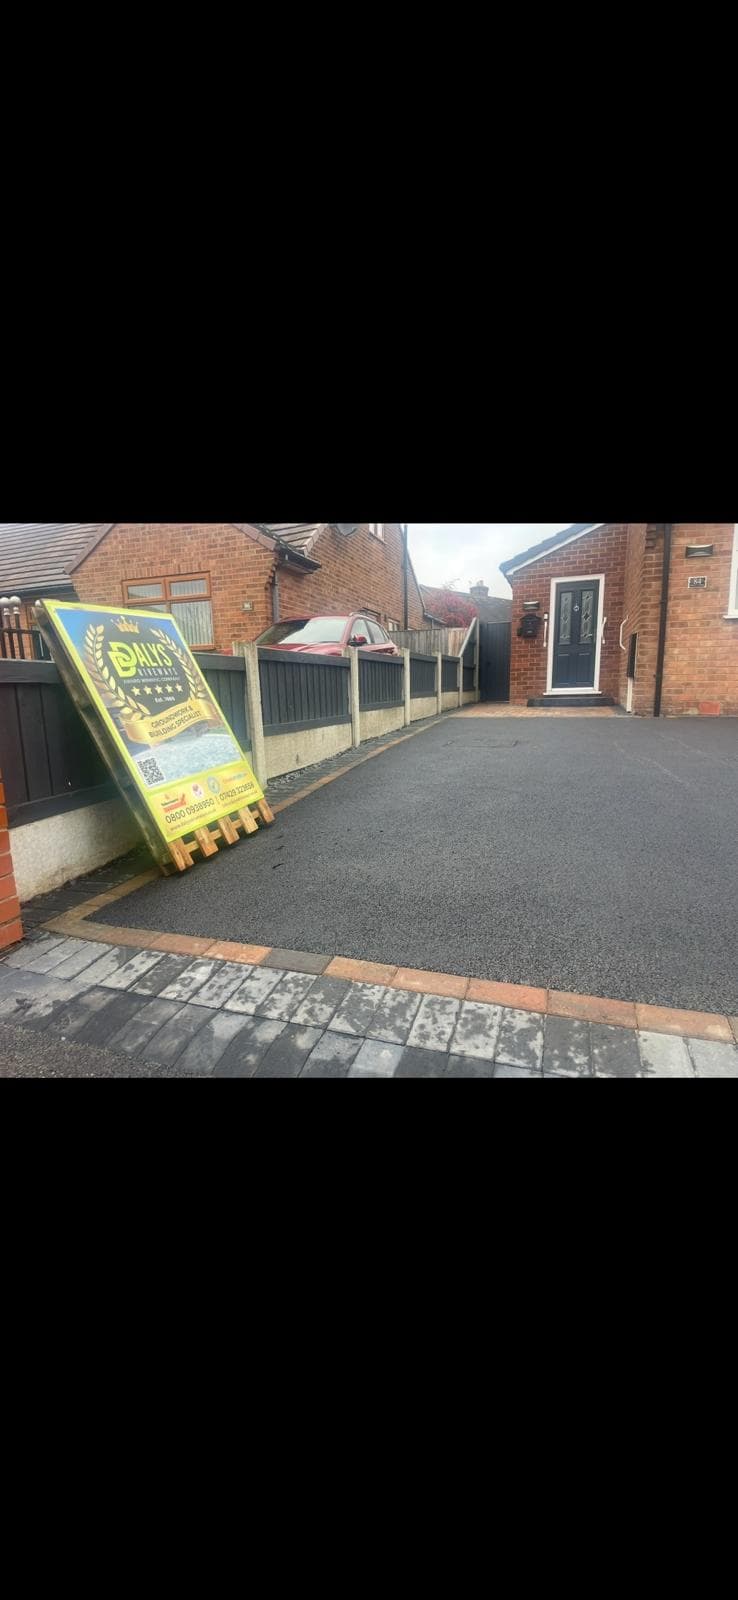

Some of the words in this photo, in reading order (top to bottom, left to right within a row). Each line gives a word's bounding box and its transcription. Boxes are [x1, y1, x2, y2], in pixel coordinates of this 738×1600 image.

[107, 641, 173, 669] DALYS
[148, 723, 176, 738] BUILDING
[175, 710, 202, 725] SPECIALIST
[151, 706, 189, 728] GROUNDWORK
[165, 811, 186, 824] 0800
